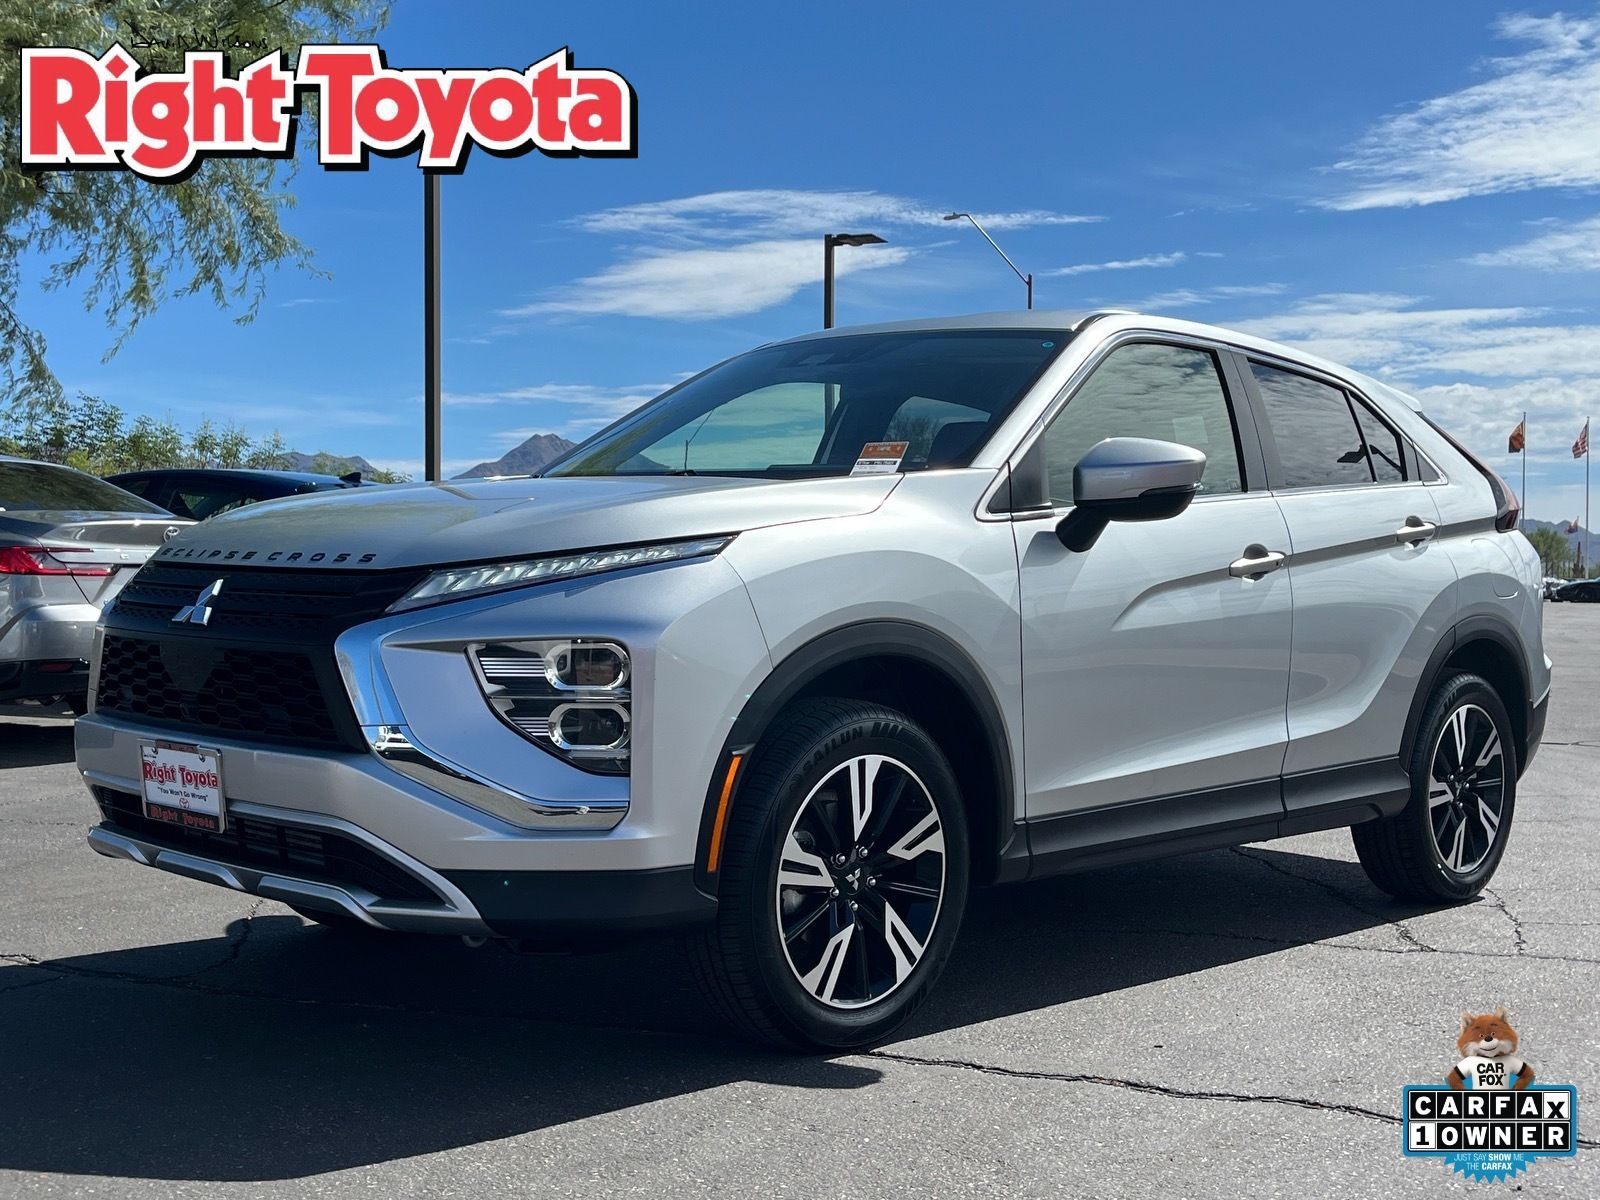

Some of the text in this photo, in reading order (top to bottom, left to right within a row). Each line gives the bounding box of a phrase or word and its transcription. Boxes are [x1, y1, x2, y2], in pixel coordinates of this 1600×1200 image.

[161, 548, 258, 560] ECLIPSE
[267, 551, 377, 563] CROSS
[143, 760, 218, 789] Right Toyota
